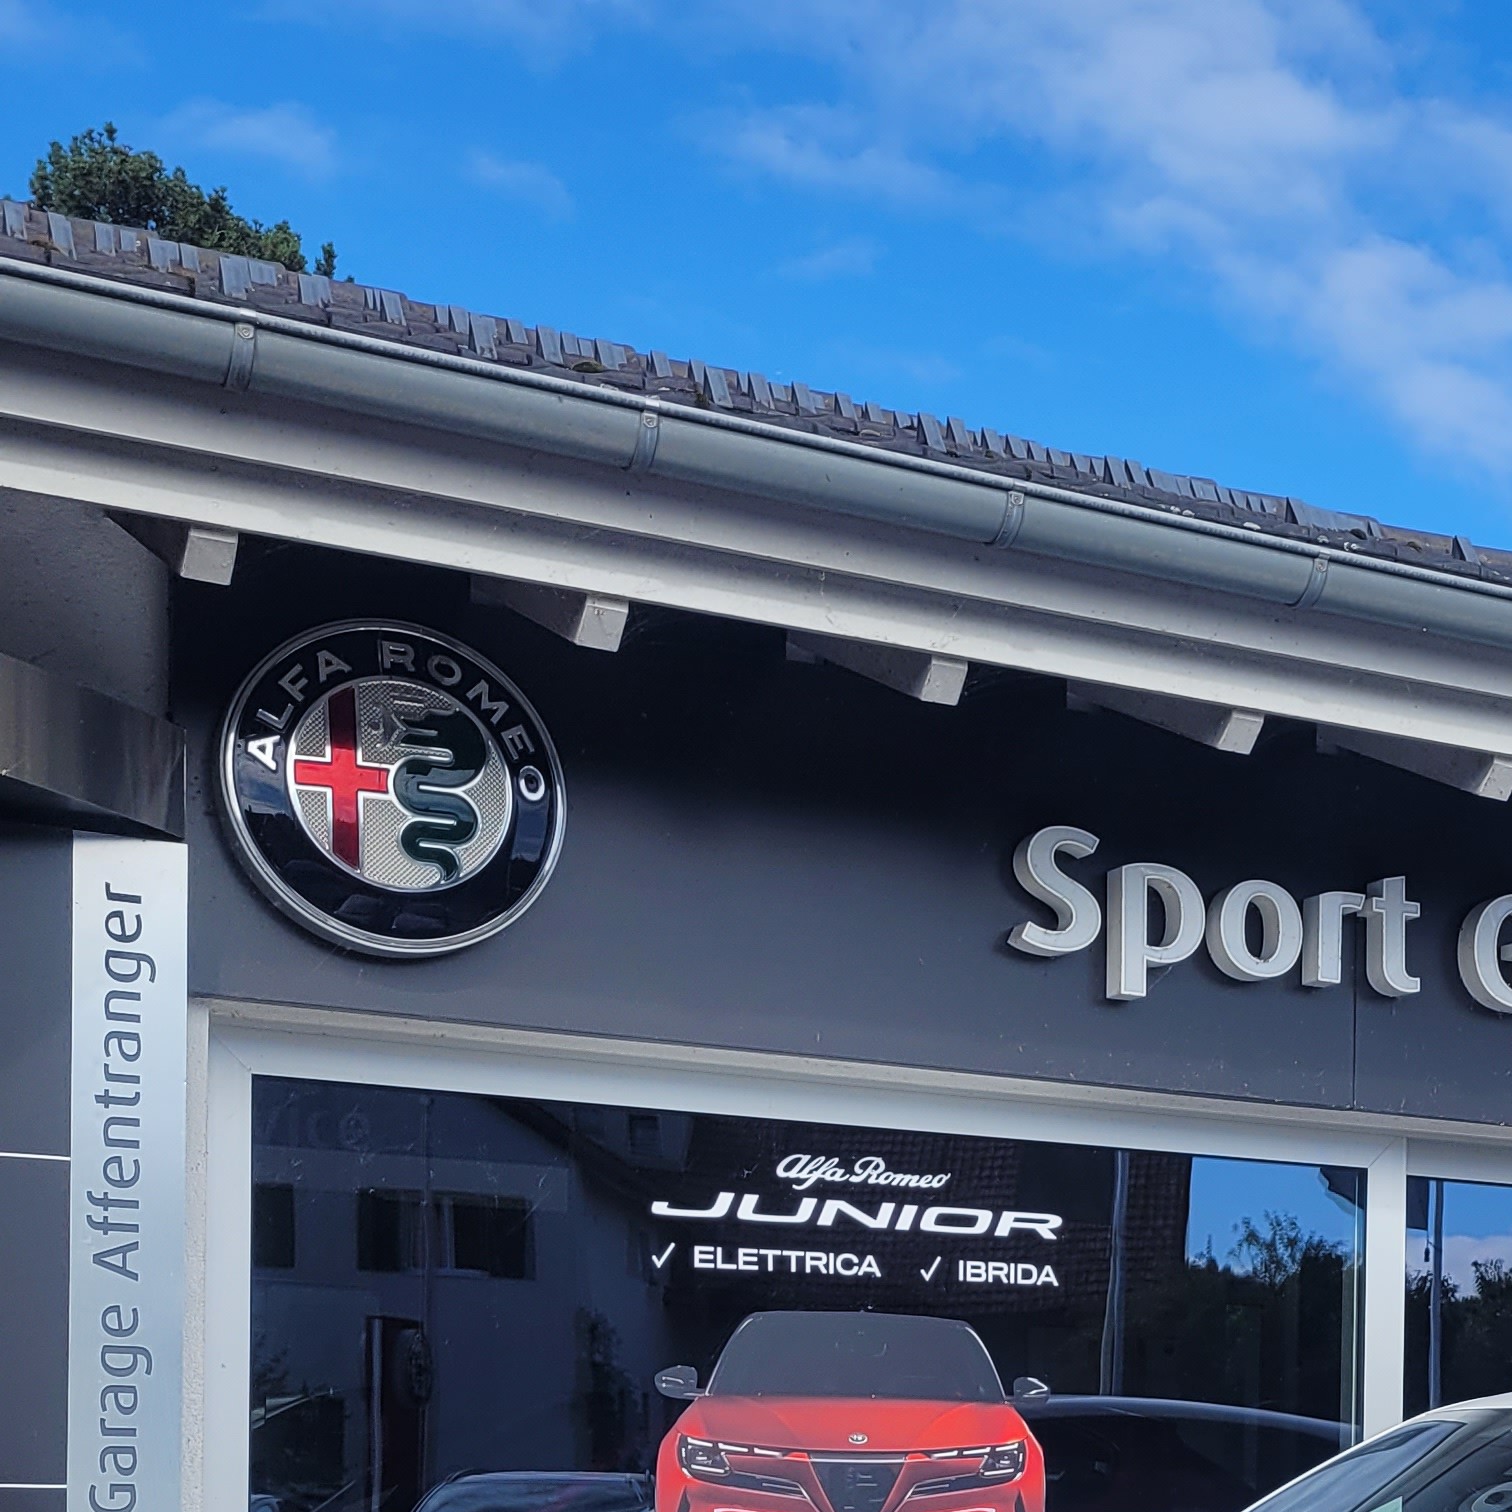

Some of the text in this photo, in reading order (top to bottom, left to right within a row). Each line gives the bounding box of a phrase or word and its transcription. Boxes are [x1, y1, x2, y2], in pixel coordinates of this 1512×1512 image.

[248, 641, 546, 801] ALFA ROMEO
[1007, 826, 1421, 1000] Sport
[86, 881, 157, 1282] Affentranger
[650, 1191, 1064, 1241] JUNIOR
[775, 1153, 952, 1190] Alfa Romeo
[693, 1245, 1060, 1287] ELETTRICA IBRIDA
